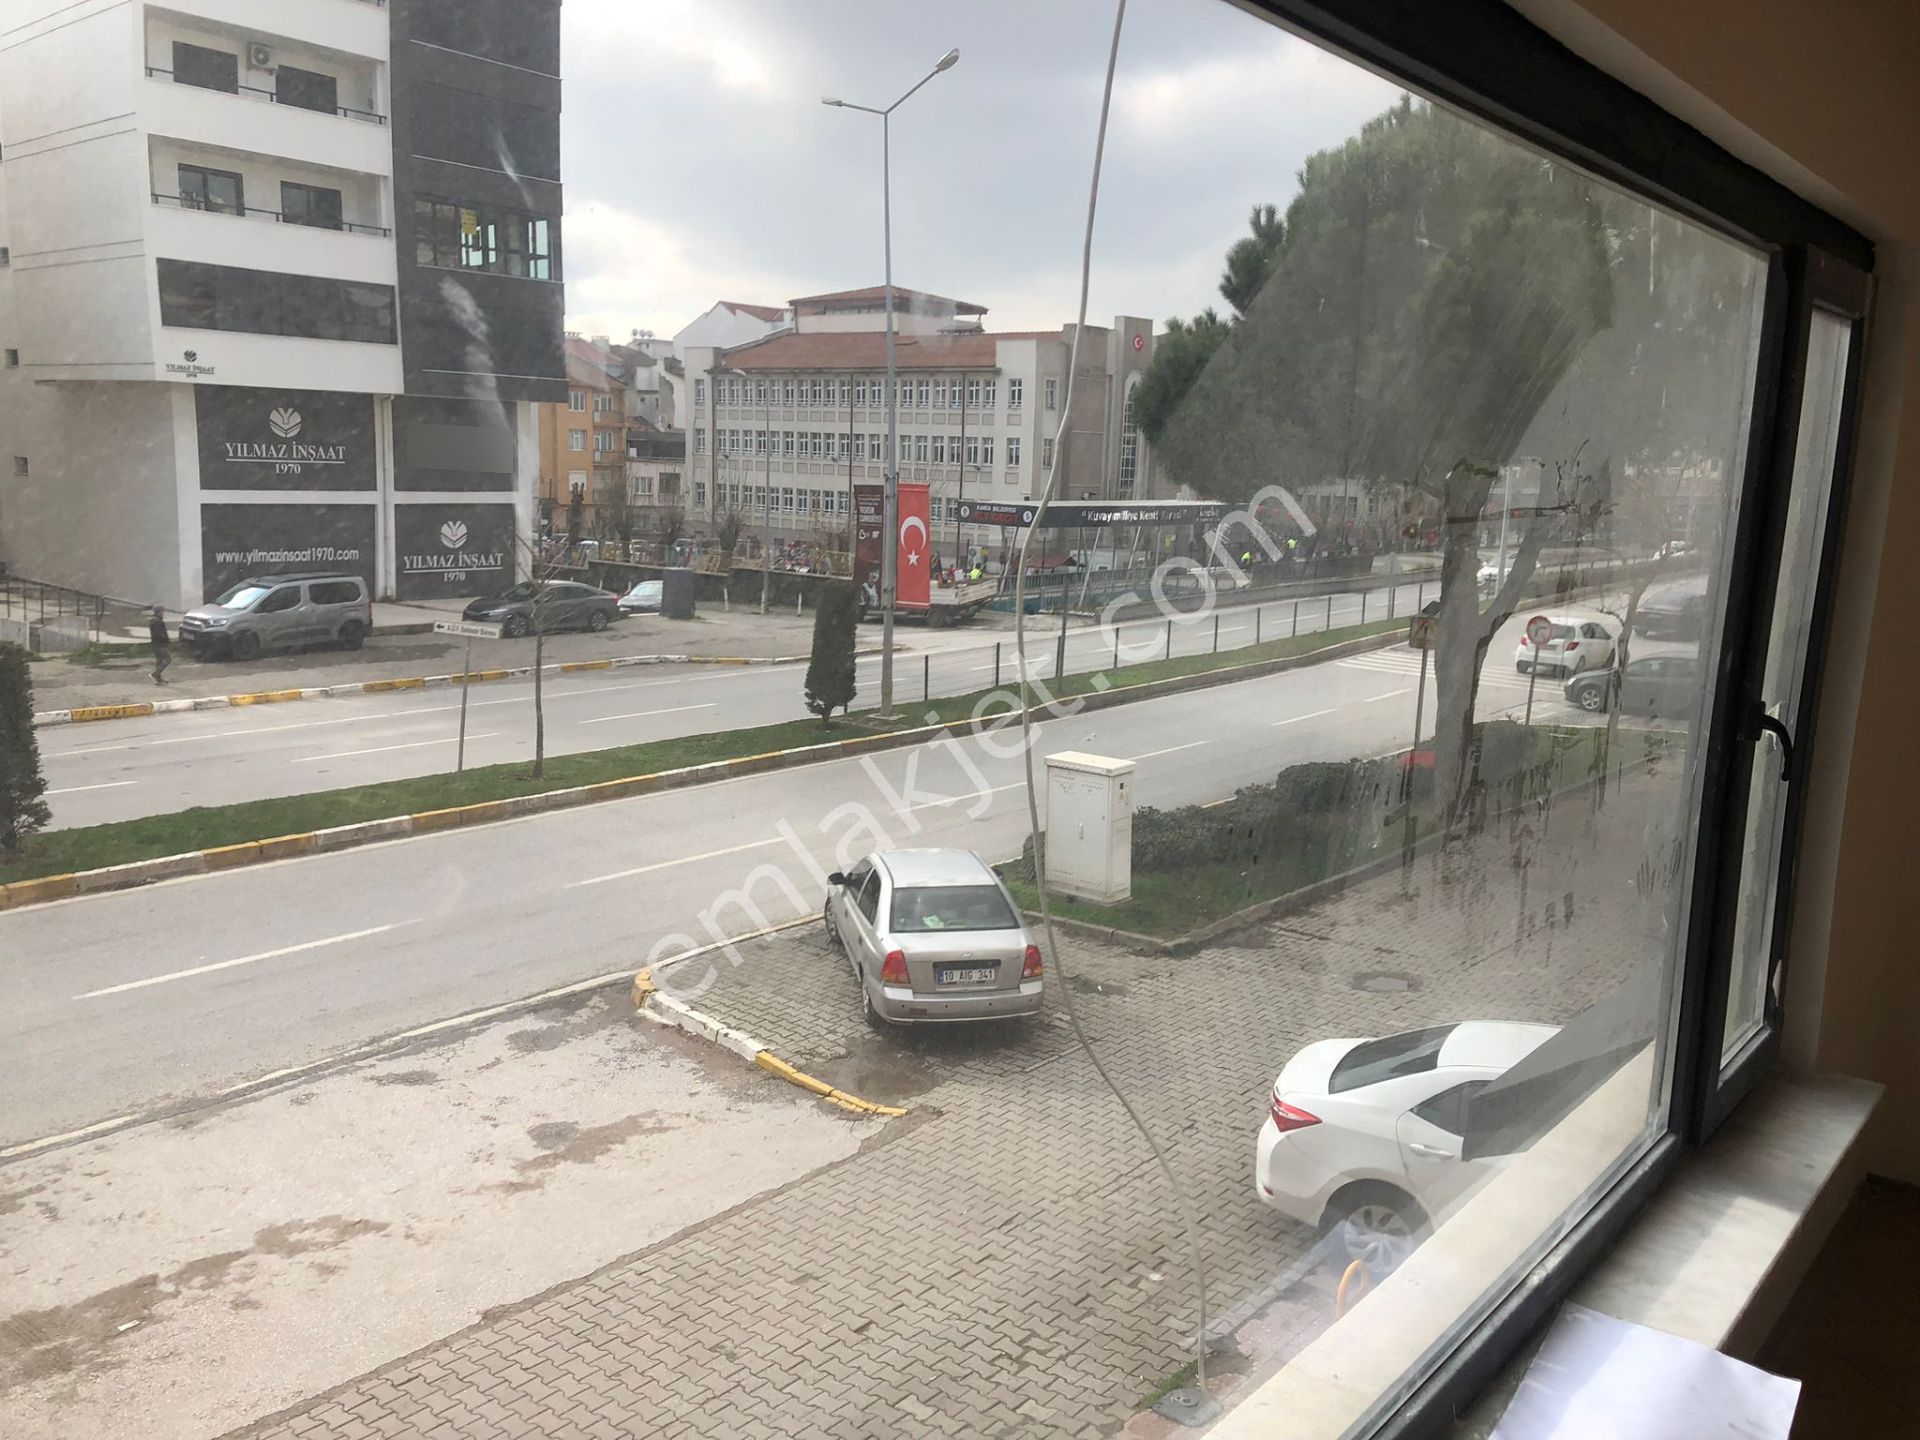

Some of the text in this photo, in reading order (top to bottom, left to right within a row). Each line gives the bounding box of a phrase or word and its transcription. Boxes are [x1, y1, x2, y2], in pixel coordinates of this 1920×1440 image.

[165, 363, 191, 371] YILMAZ
[225, 440, 346, 461] YILMAZ İNŞAAT
[275, 463, 302, 474] 1970
[215, 547, 360, 566] www.yilmazinsaat1970.com
[403, 550, 504, 569] YILMAZ İNŞAAT
[443, 571, 466, 582] 1970
[944, 971, 954, 981] 10
[978, 969, 993, 980] 341
